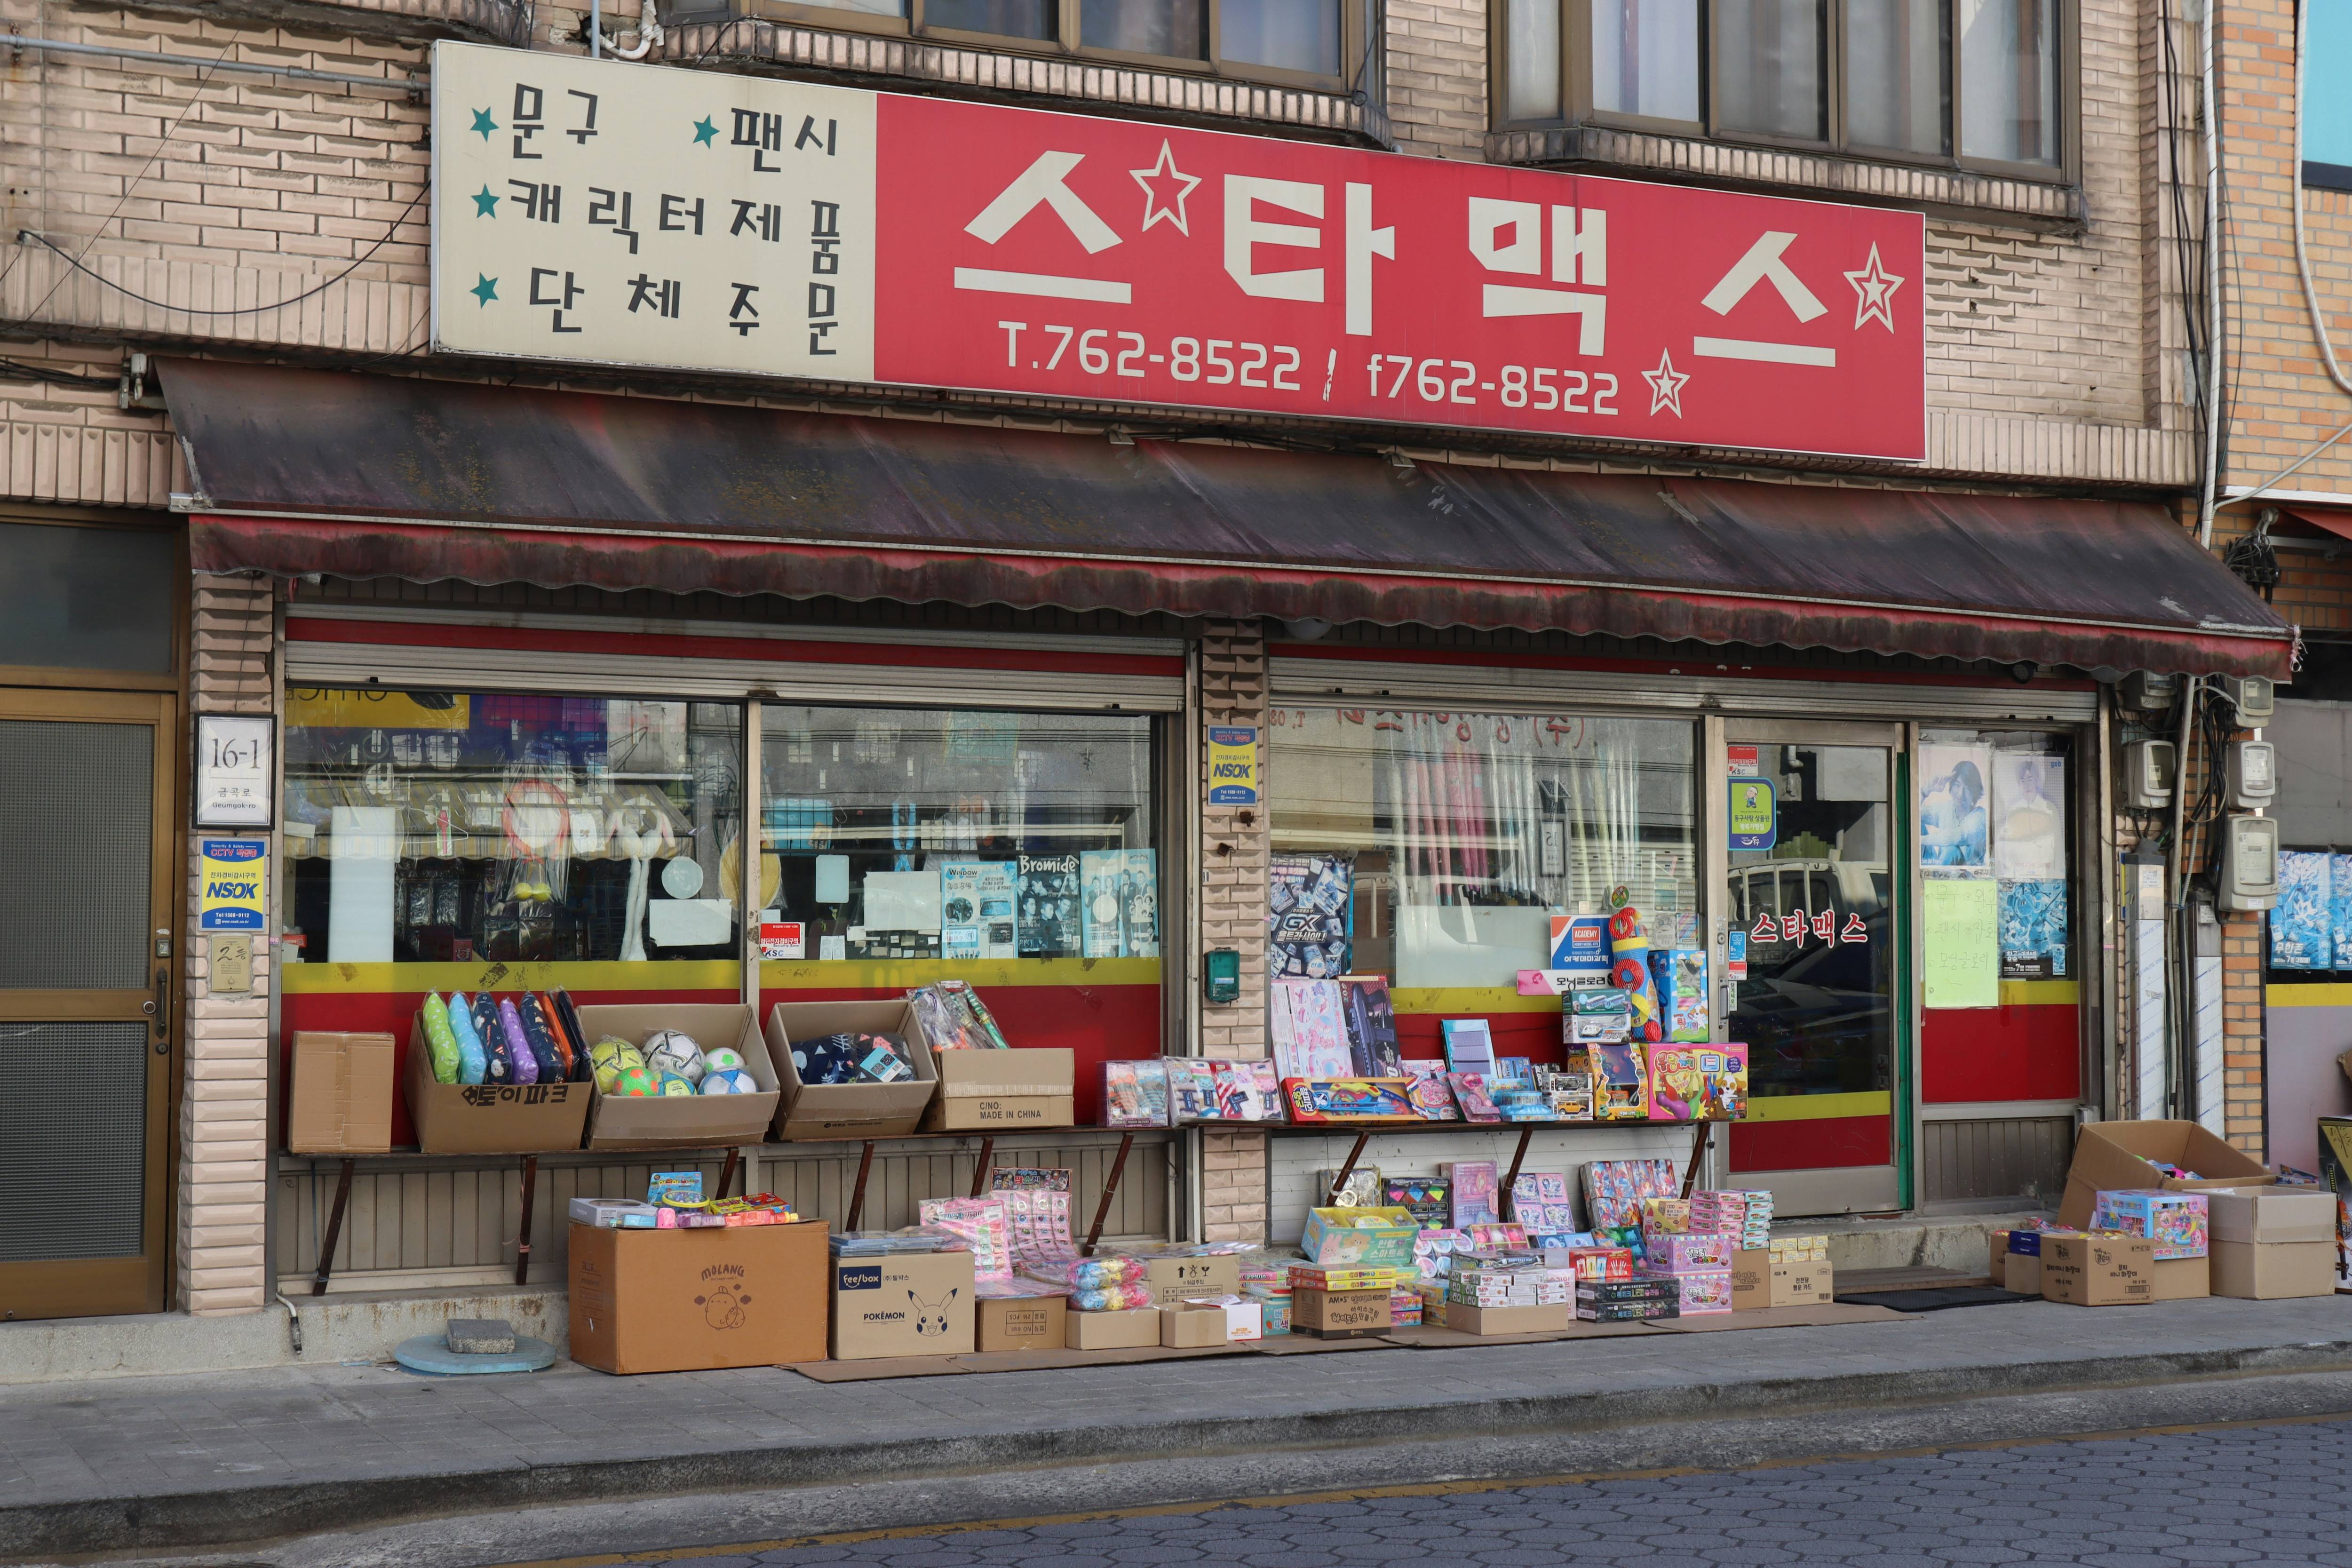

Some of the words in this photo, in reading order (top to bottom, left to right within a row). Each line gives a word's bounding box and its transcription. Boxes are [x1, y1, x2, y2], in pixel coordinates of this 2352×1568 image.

[513, 83, 598, 159] 문구
[731, 107, 837, 173] 팬시
[953, 149, 1837, 368] 스타맥스
[529, 267, 839, 356] 단체주문
[997, 320, 1302, 392] T.762-8522
[1366, 354, 1620, 416] f762-8522
[211, 738, 261, 769] 16-1
[1213, 764, 1252, 779] NSOK
[218, 788, 252, 797] 금곡로
[237, 849, 257, 857] 작동중
[1019, 855, 1076, 875] Bromide
[206, 882, 259, 899] NSOK
[1934, 884, 1959, 909] 문구
[1750, 908, 1868, 949] 스타맥스
[1564, 955, 1608, 964] 아카데미과학
[1557, 977, 1605, 992] 모닝글로리
[1657, 1051, 1694, 1072] 볼링게임
[477, 1085, 568, 1106] 토이파크
[1377, 1239, 1396, 1249] 인형
[1369, 1248, 1406, 1258] 스마트톡
[701, 1264, 744, 1281] MOLANG
[864, 1311, 905, 1321] POKÉMON
[1351, 1306, 1379, 1318] 아이스크림
